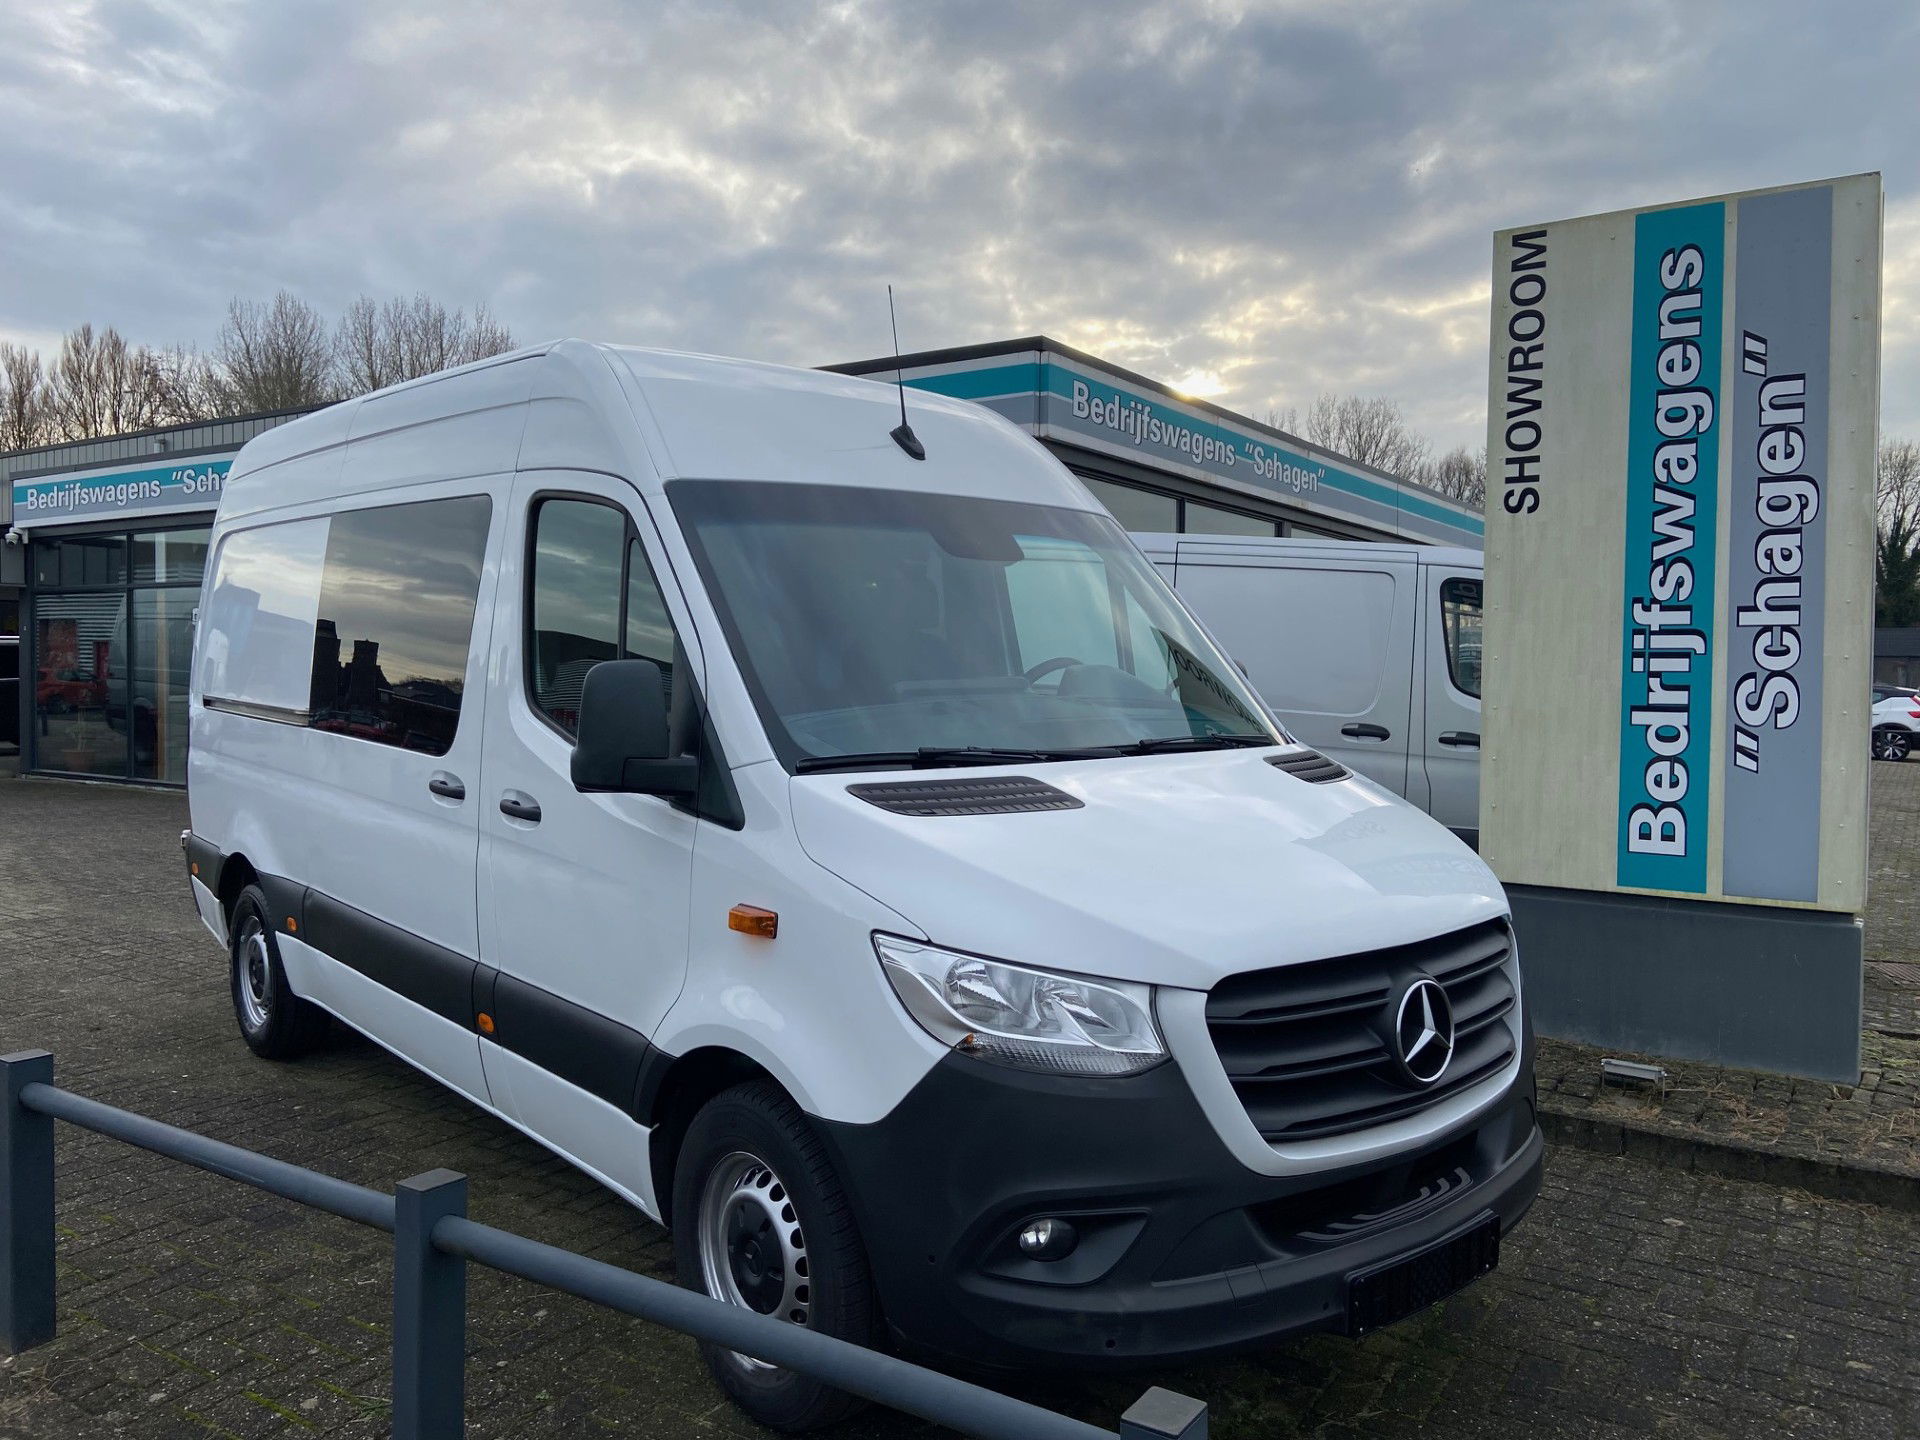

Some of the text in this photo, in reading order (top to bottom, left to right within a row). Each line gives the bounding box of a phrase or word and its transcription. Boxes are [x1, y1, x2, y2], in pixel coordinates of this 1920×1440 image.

[1072, 379, 1237, 466] Bedrijfswagens
[1503, 228, 1548, 514] SHOWROOM
[27, 479, 161, 511] Bedrijfswagens
[1627, 242, 1714, 857] Bedrijfswagens
